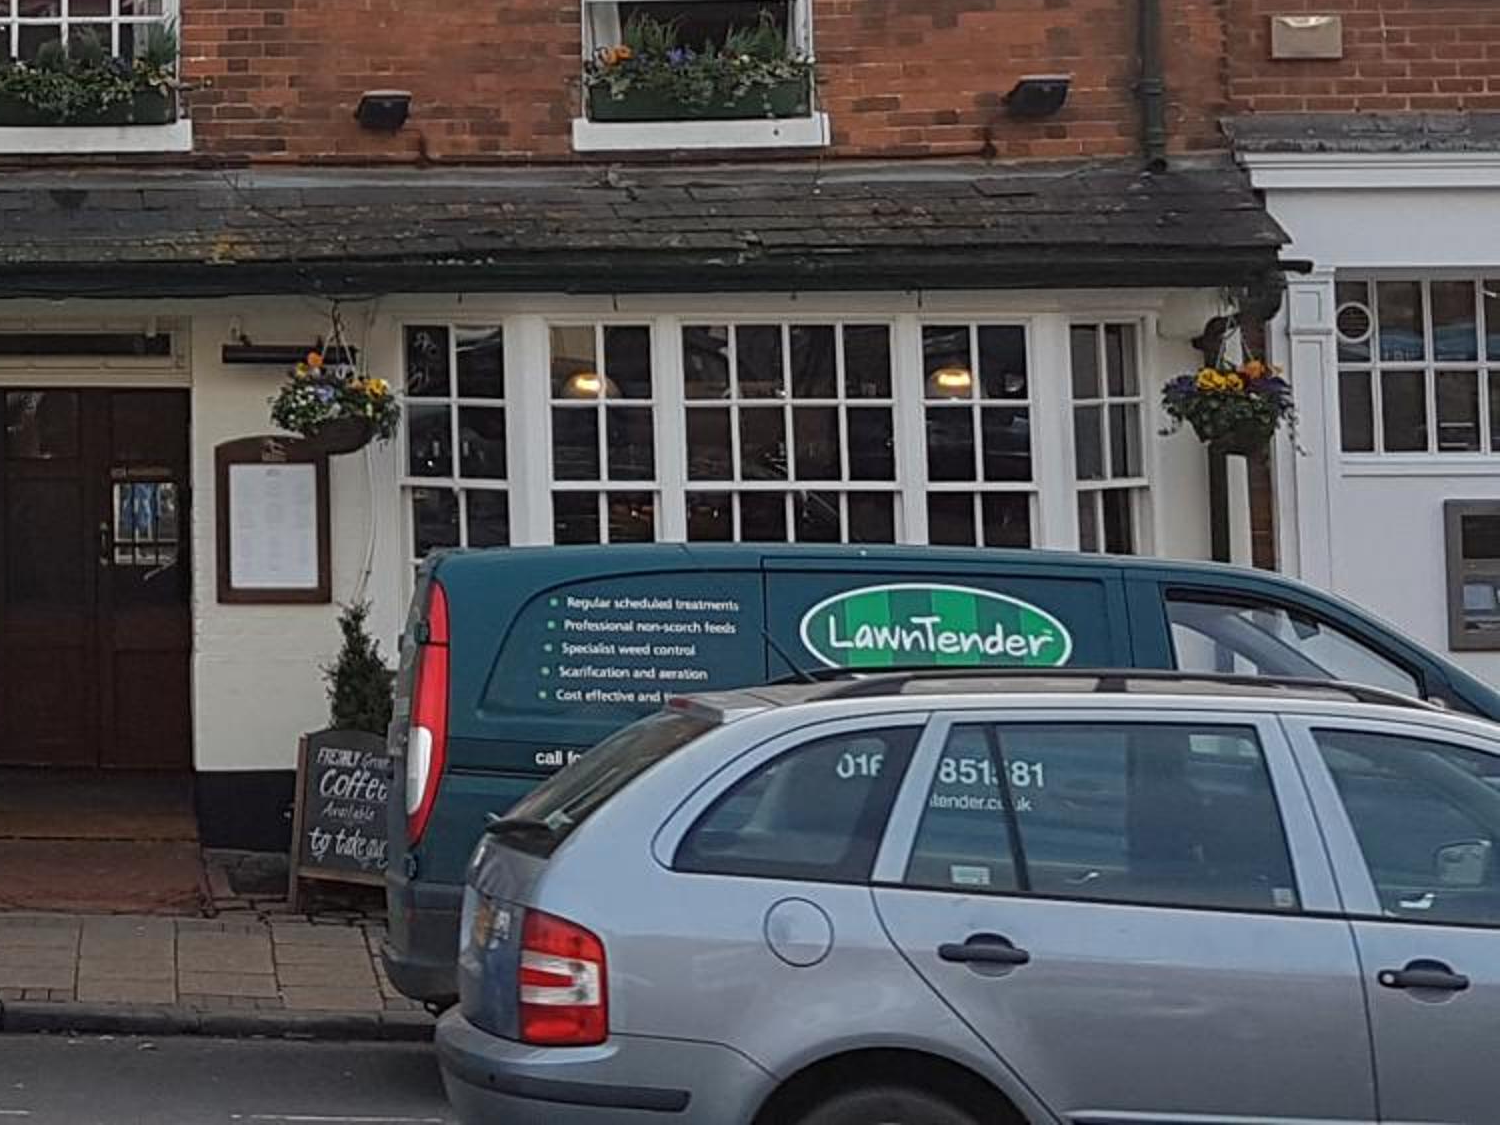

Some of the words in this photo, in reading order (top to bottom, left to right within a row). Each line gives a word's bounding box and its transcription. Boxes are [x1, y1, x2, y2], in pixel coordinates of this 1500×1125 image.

[566, 597, 611, 612] Regular
[614, 598, 673, 610] scheduled
[676, 599, 739, 612] treatments
[564, 620, 634, 632] Professional
[636, 621, 701, 634] non-scorch
[704, 621, 736, 635] feeds
[828, 614, 1055, 657] LawnTender
[562, 643, 615, 657] Specialist
[619, 643, 650, 655] weed
[653, 644, 695, 656] control
[559, 666, 630, 679] Scarification
[633, 667, 656, 679] and
[659, 668, 709, 680] aeration
[556, 689, 582, 701] Cost
[585, 690, 635, 702] effective
[638, 691, 661, 702] and
[535, 751, 563, 765] call
[938, 757, 1045, 789] 85181
